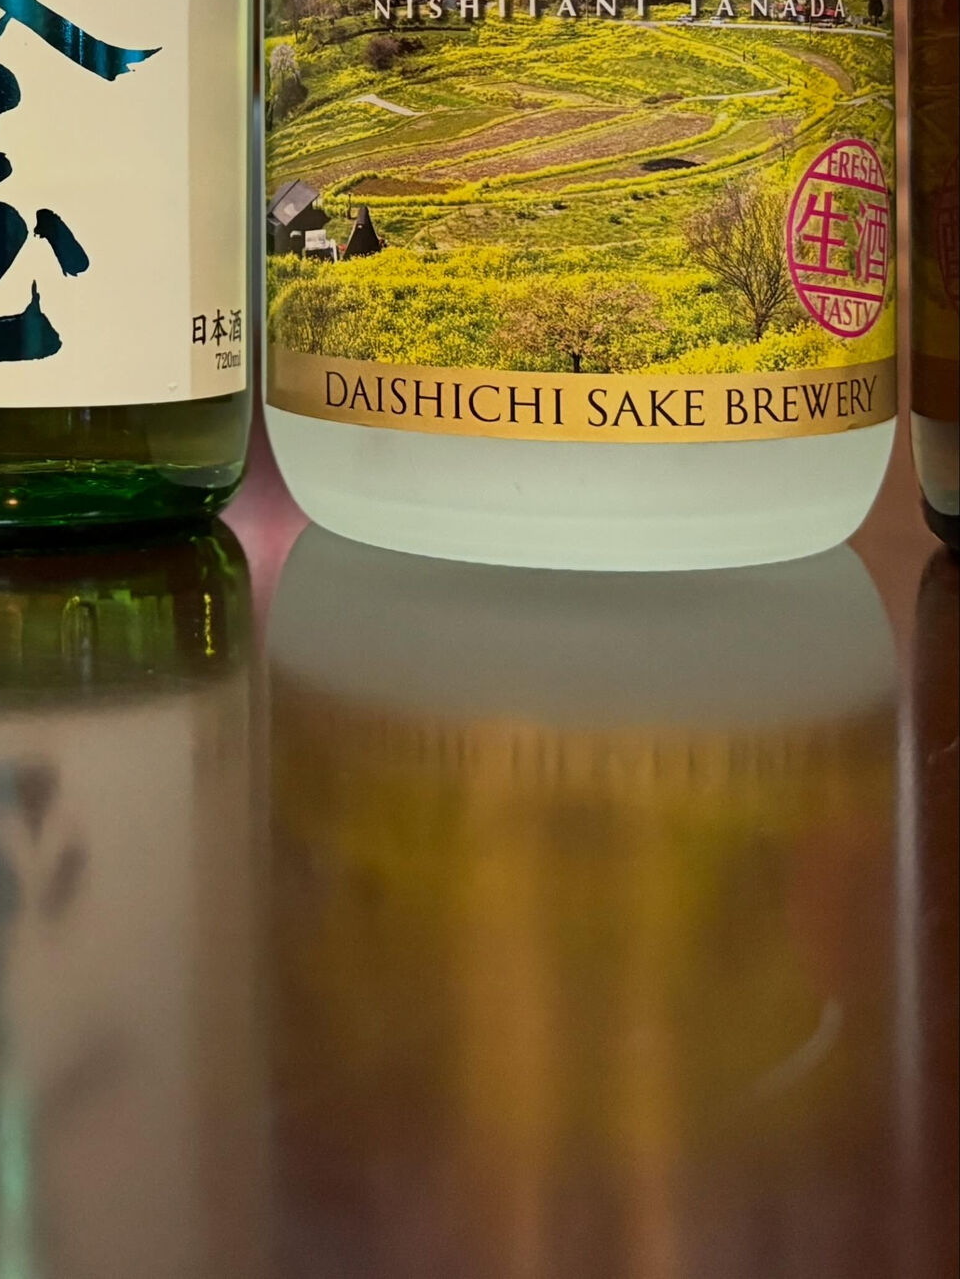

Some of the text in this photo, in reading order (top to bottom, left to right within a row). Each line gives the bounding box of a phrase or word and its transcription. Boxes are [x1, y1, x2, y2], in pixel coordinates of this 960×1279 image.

[827, 150, 880, 185] FRESH
[796, 192, 886, 286] 生酒
[192, 308, 242, 346] 日本酒
[817, 295, 874, 327] TASTY
[326, 370, 878, 428] DAISHICHI SAKE BREWERY
